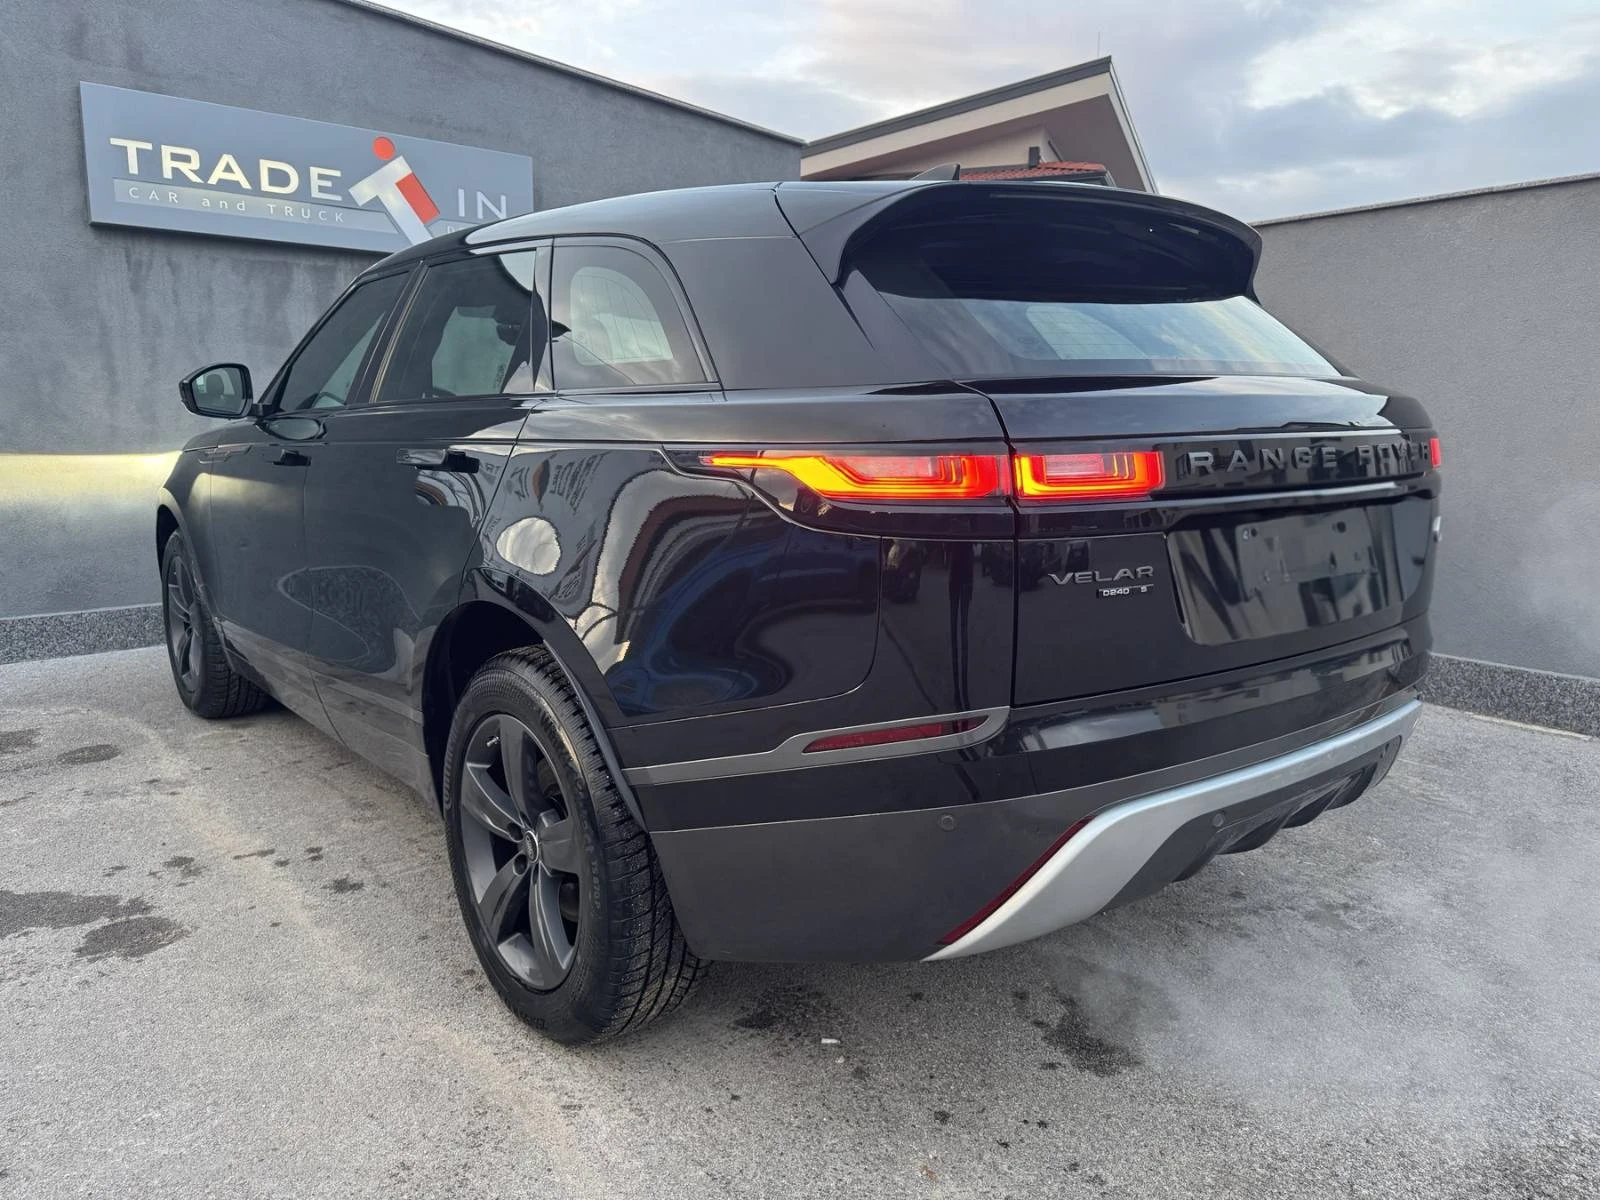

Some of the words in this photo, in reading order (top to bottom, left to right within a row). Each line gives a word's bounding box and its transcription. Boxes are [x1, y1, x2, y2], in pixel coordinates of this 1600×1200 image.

[110, 137, 343, 202] TRADE
[457, 188, 507, 219] IN
[127, 186, 179, 204] CAR
[201, 196, 247, 213] and
[267, 202, 345, 224] TRUCK
[1187, 445, 1338, 477] RANGE
[1047, 565, 1155, 586] VELAR
[1102, 587, 1130, 598] D240
